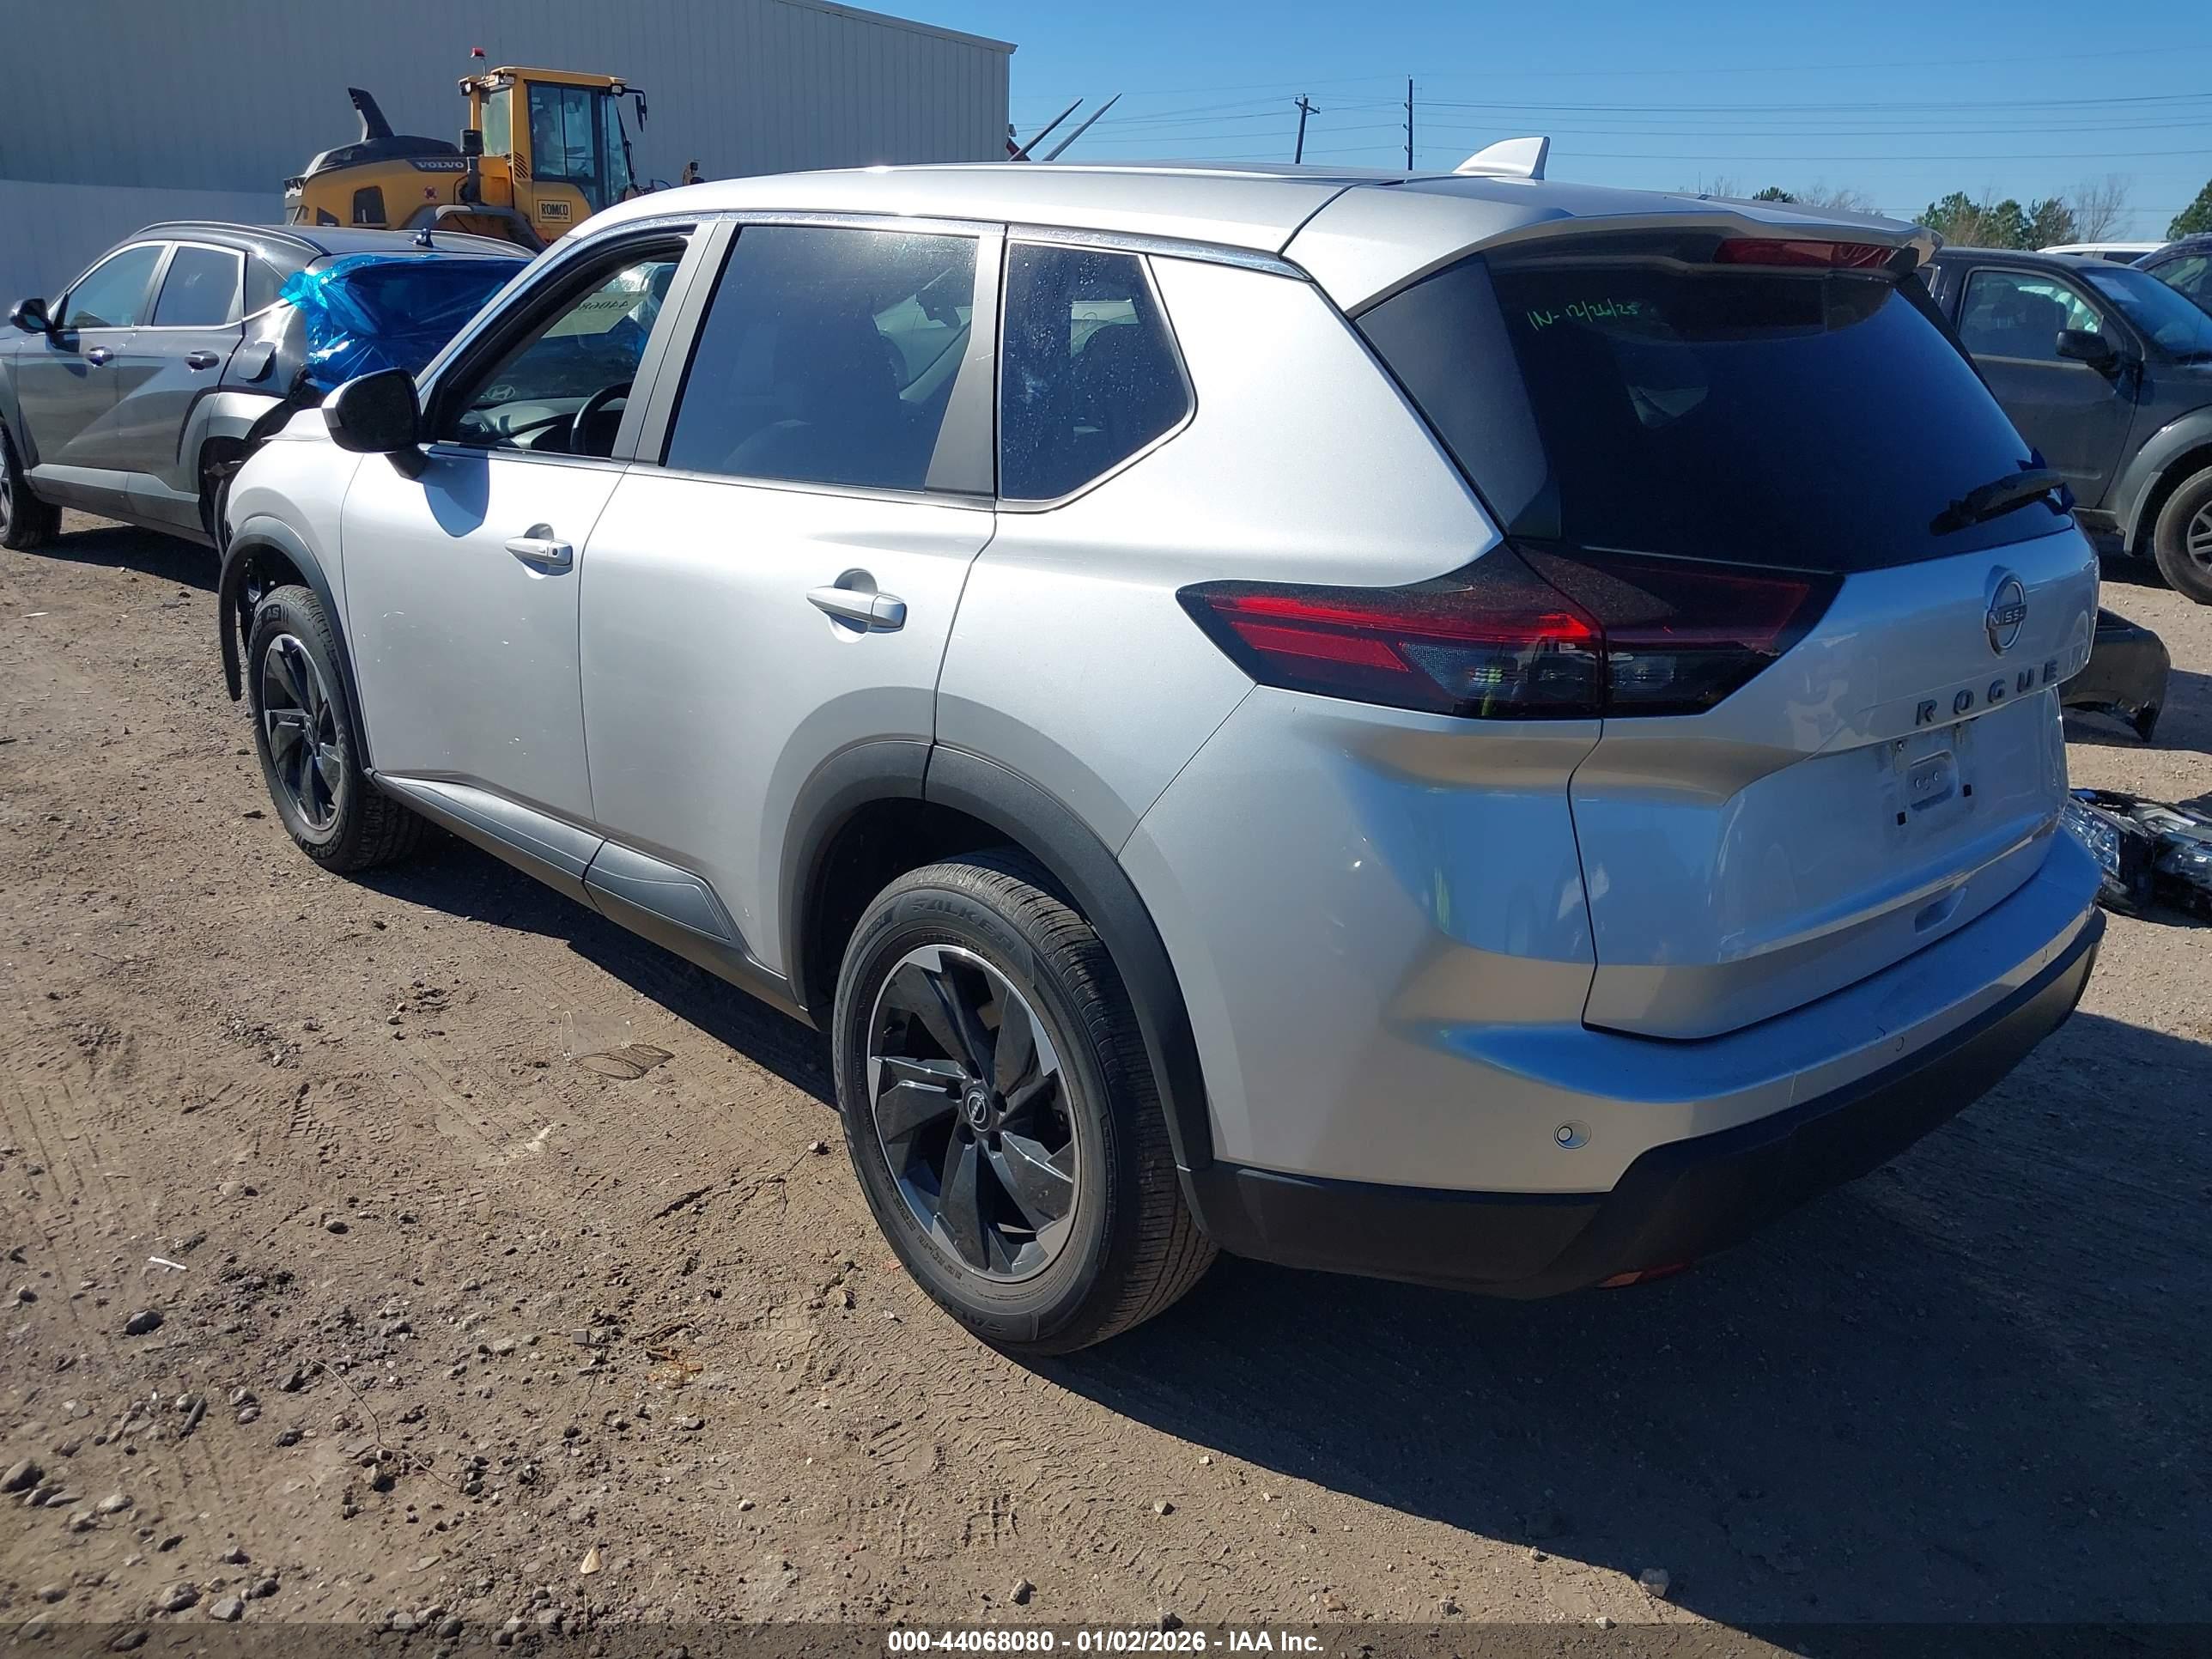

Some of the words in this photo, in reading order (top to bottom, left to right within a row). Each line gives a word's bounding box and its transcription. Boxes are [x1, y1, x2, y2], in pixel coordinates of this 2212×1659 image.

[541, 203, 568, 216] ROMCO
[1990, 607, 2025, 625] NISS
[1916, 659, 2057, 726] ROGUE
[911, 897, 1016, 954] FALKEN
